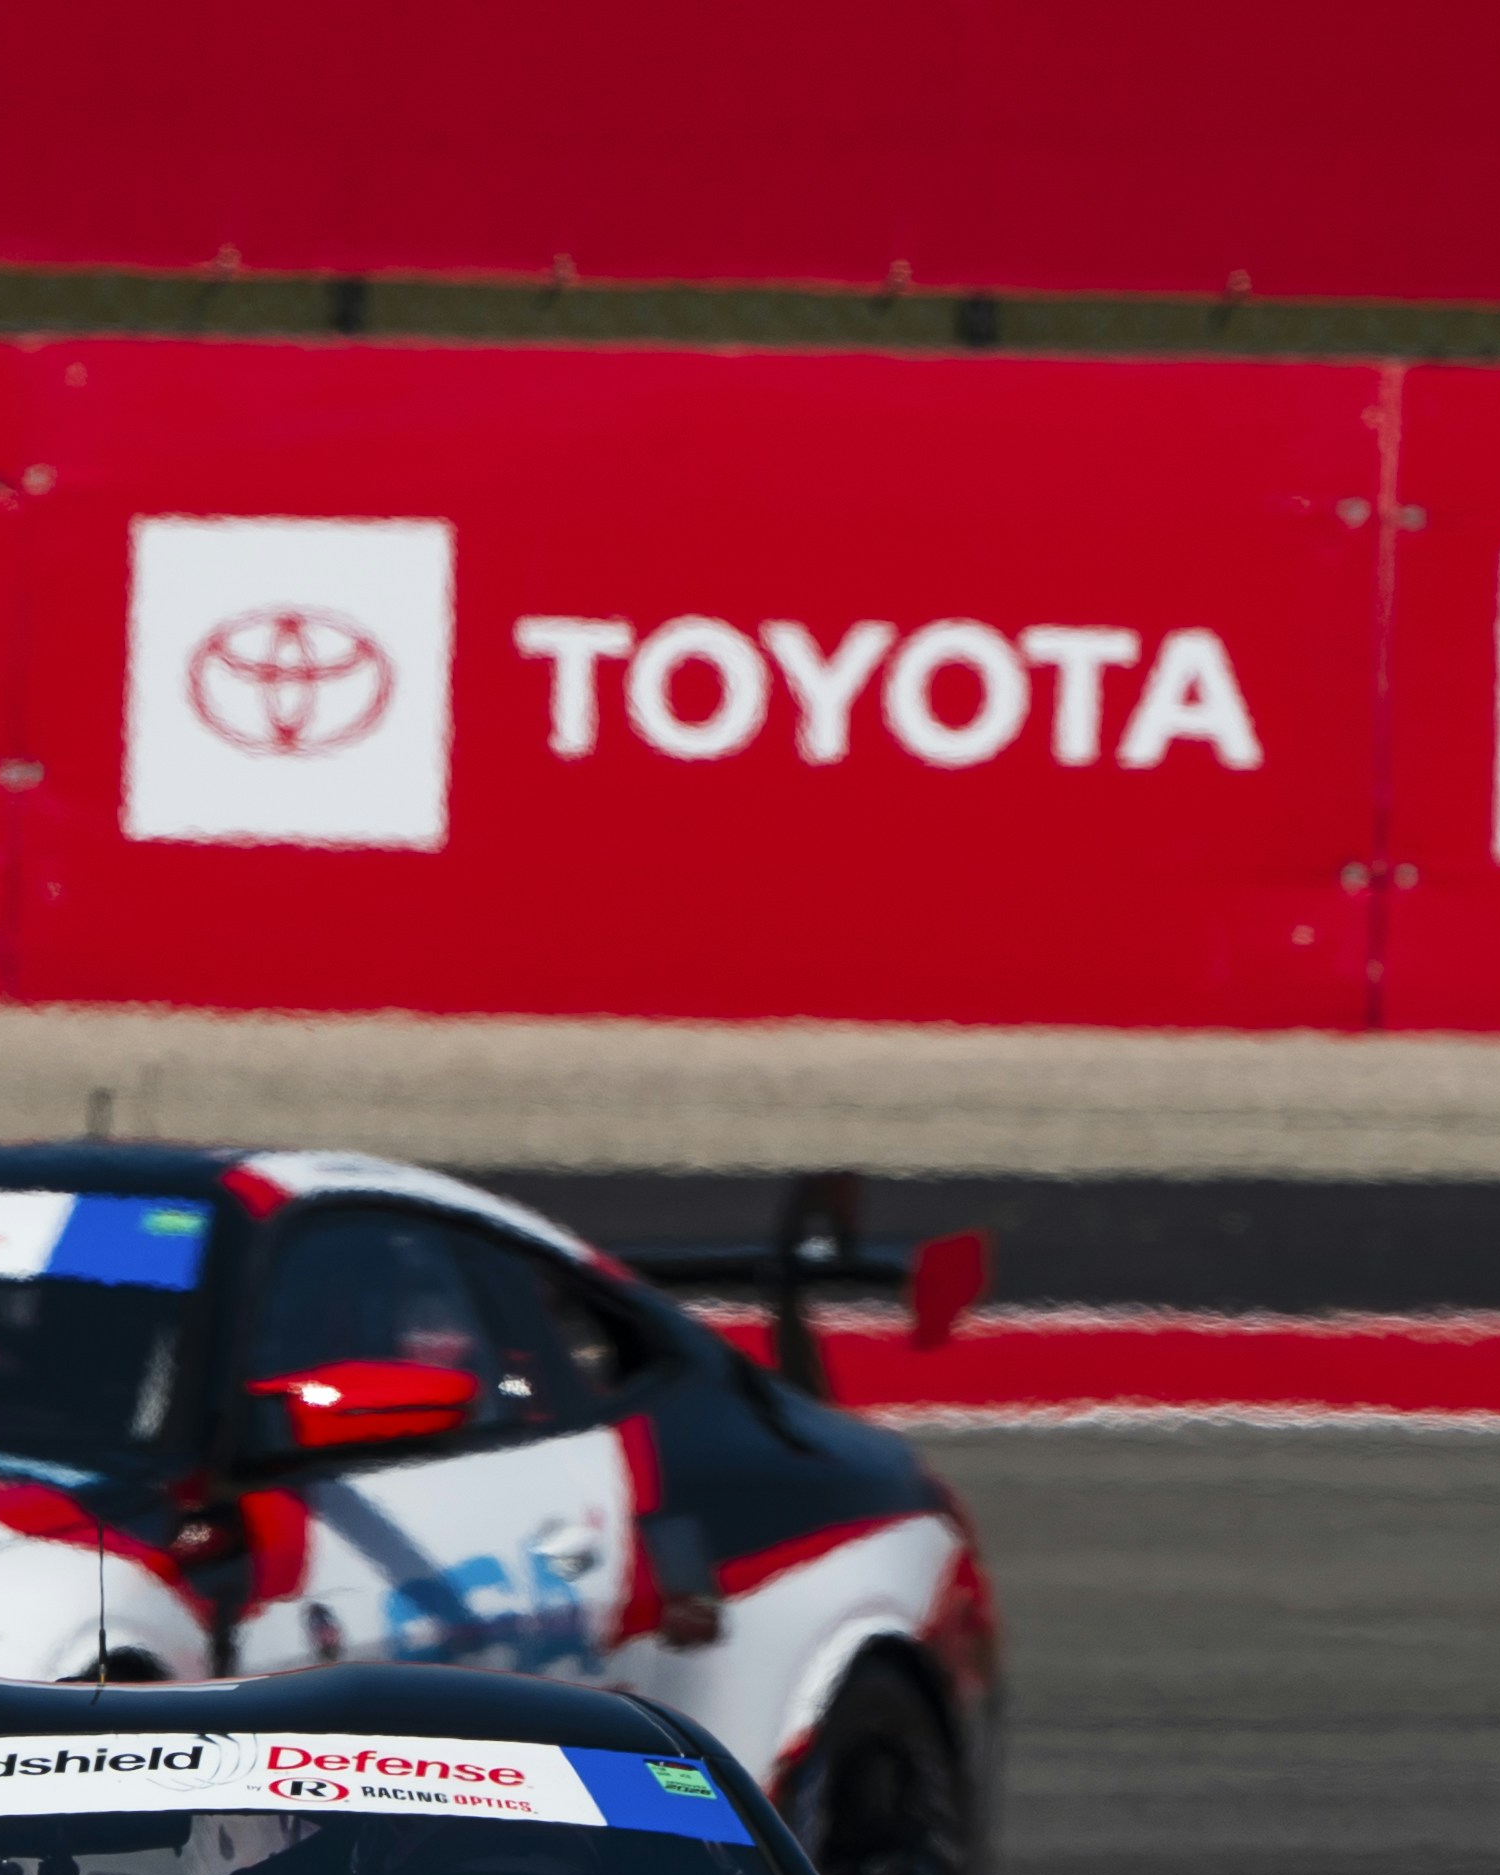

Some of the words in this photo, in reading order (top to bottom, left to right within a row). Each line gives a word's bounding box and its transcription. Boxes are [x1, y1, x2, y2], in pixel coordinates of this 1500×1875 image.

[515, 616, 1261, 769] TOYOTA
[266, 1745, 526, 1787] Defense
[361, 1785, 449, 1804] RACING
[453, 1794, 533, 1813] OPTICS
